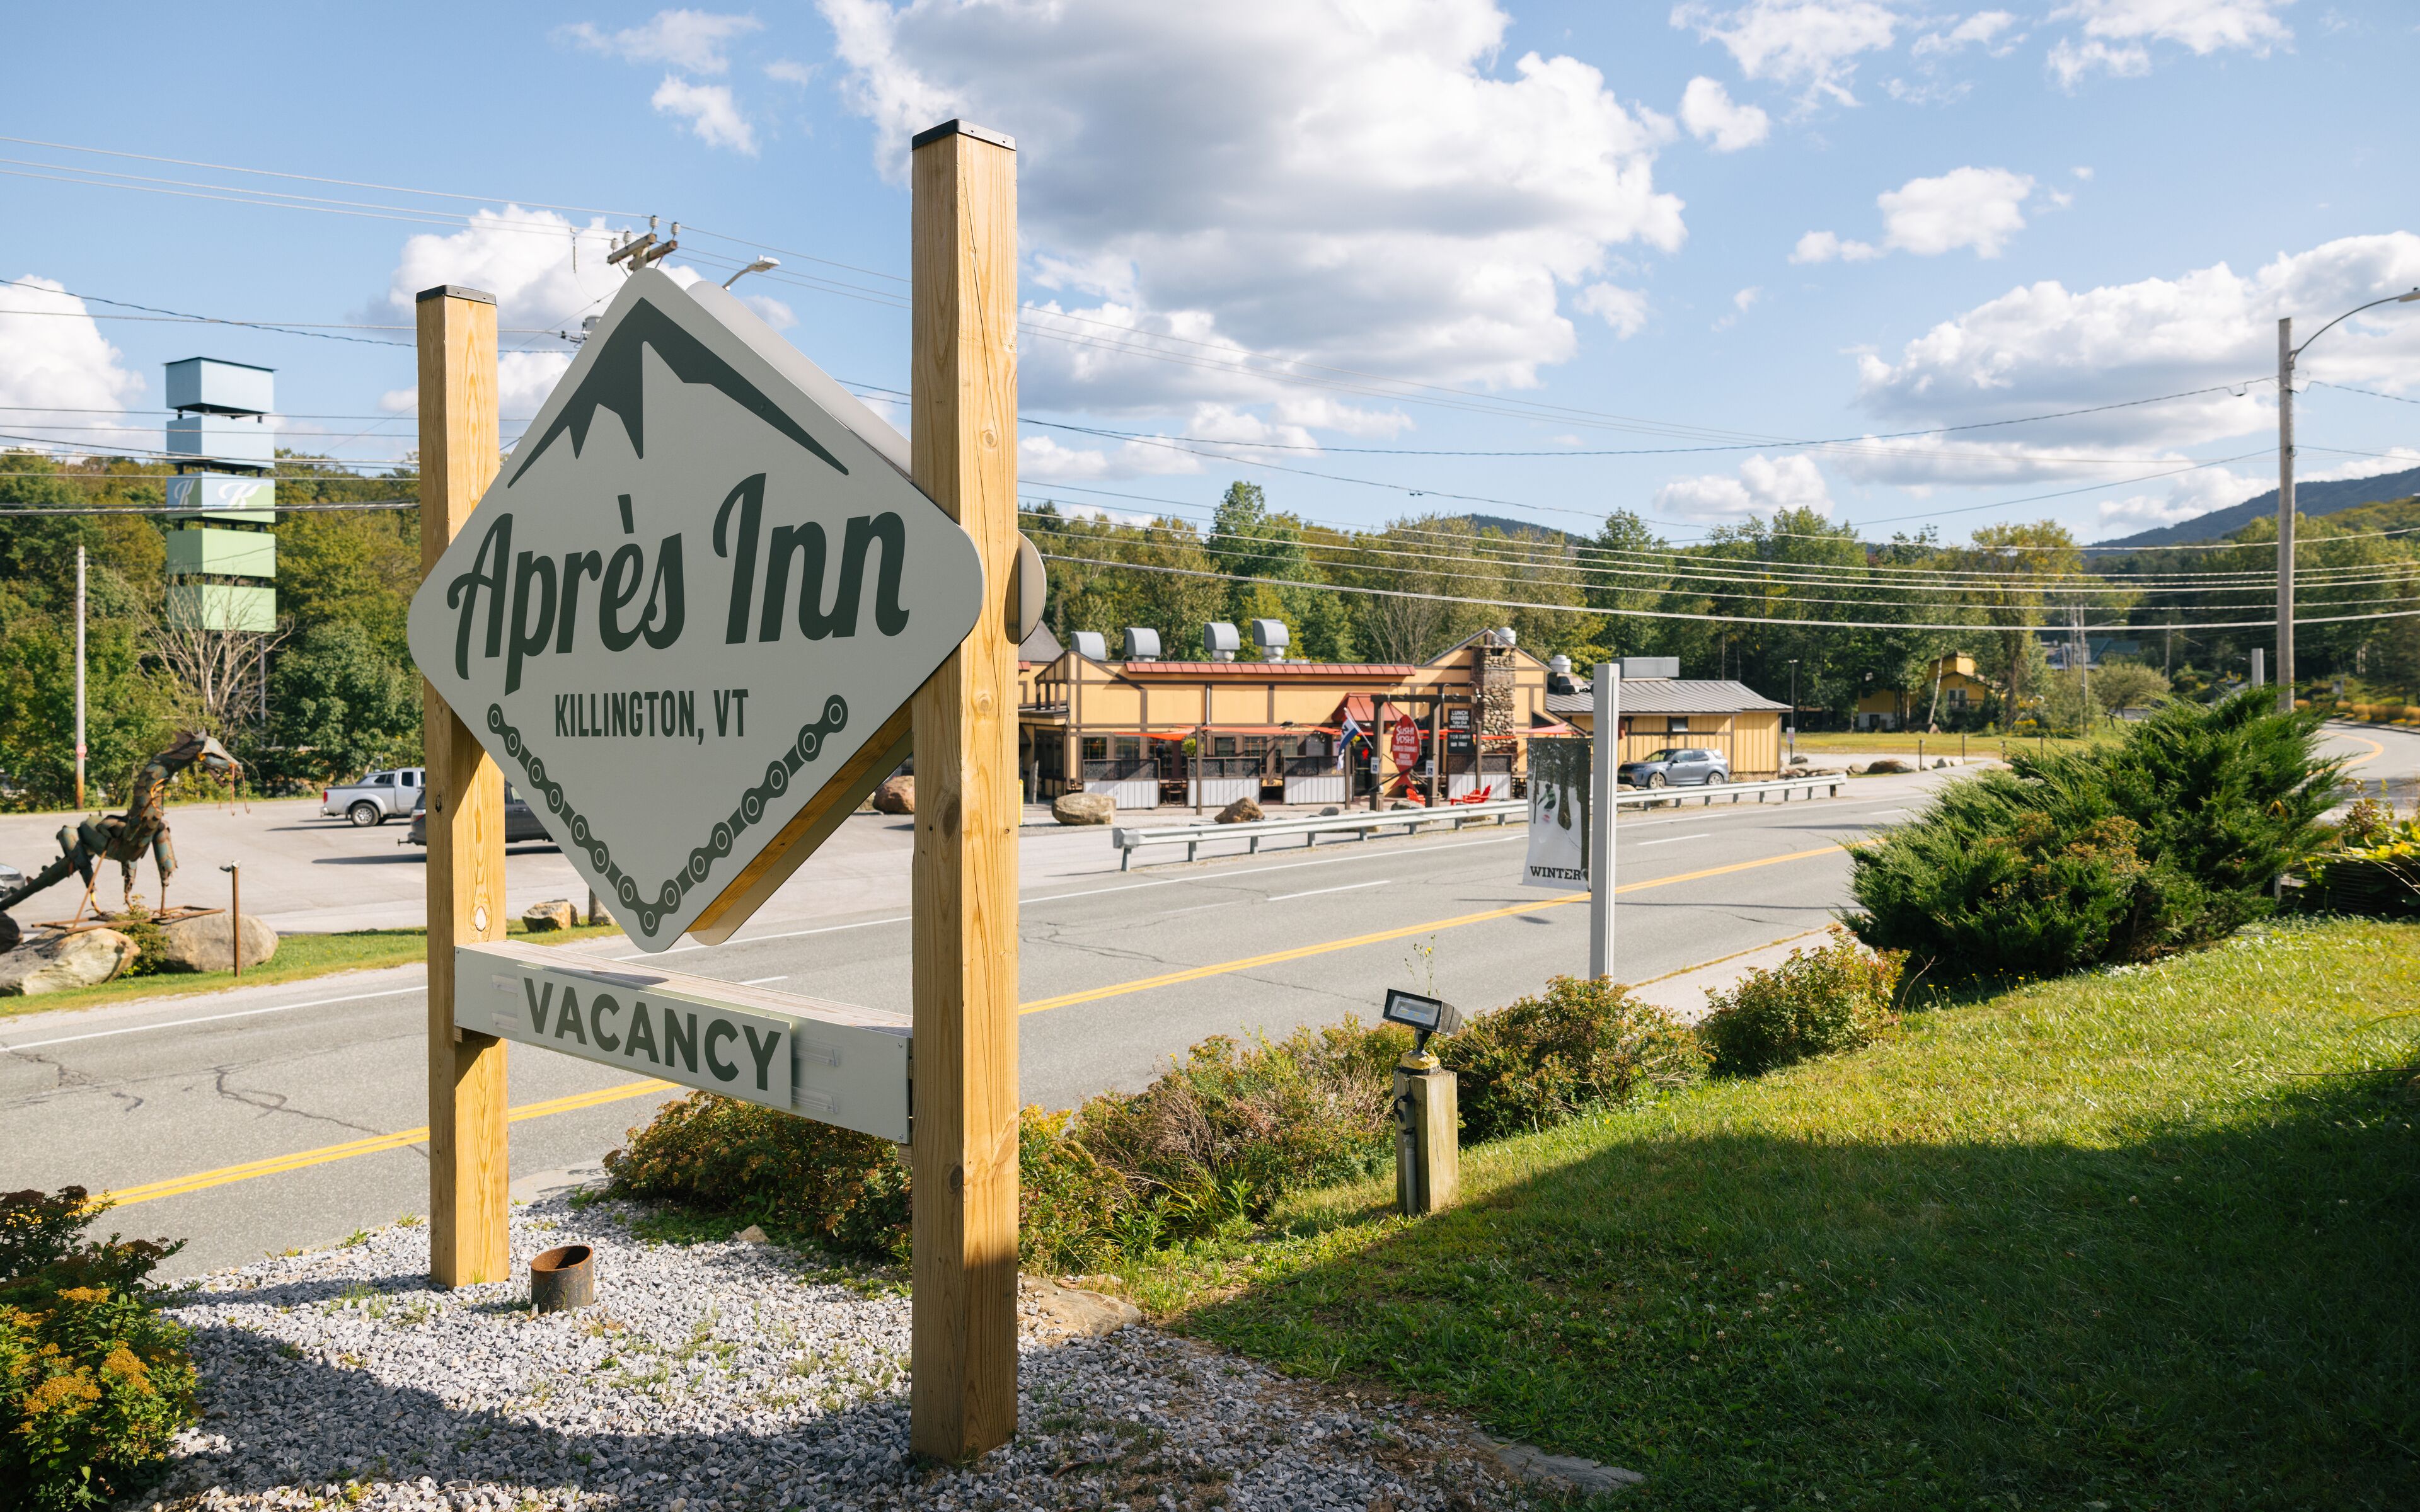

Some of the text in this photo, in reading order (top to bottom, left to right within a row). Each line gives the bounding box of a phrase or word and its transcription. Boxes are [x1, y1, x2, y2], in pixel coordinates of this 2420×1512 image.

[447, 472, 910, 697] Après Inn
[555, 689, 749, 745] KILLINGTON, VT
[1530, 866, 1581, 881] WINTER
[524, 977, 781, 1091] VACANCY
